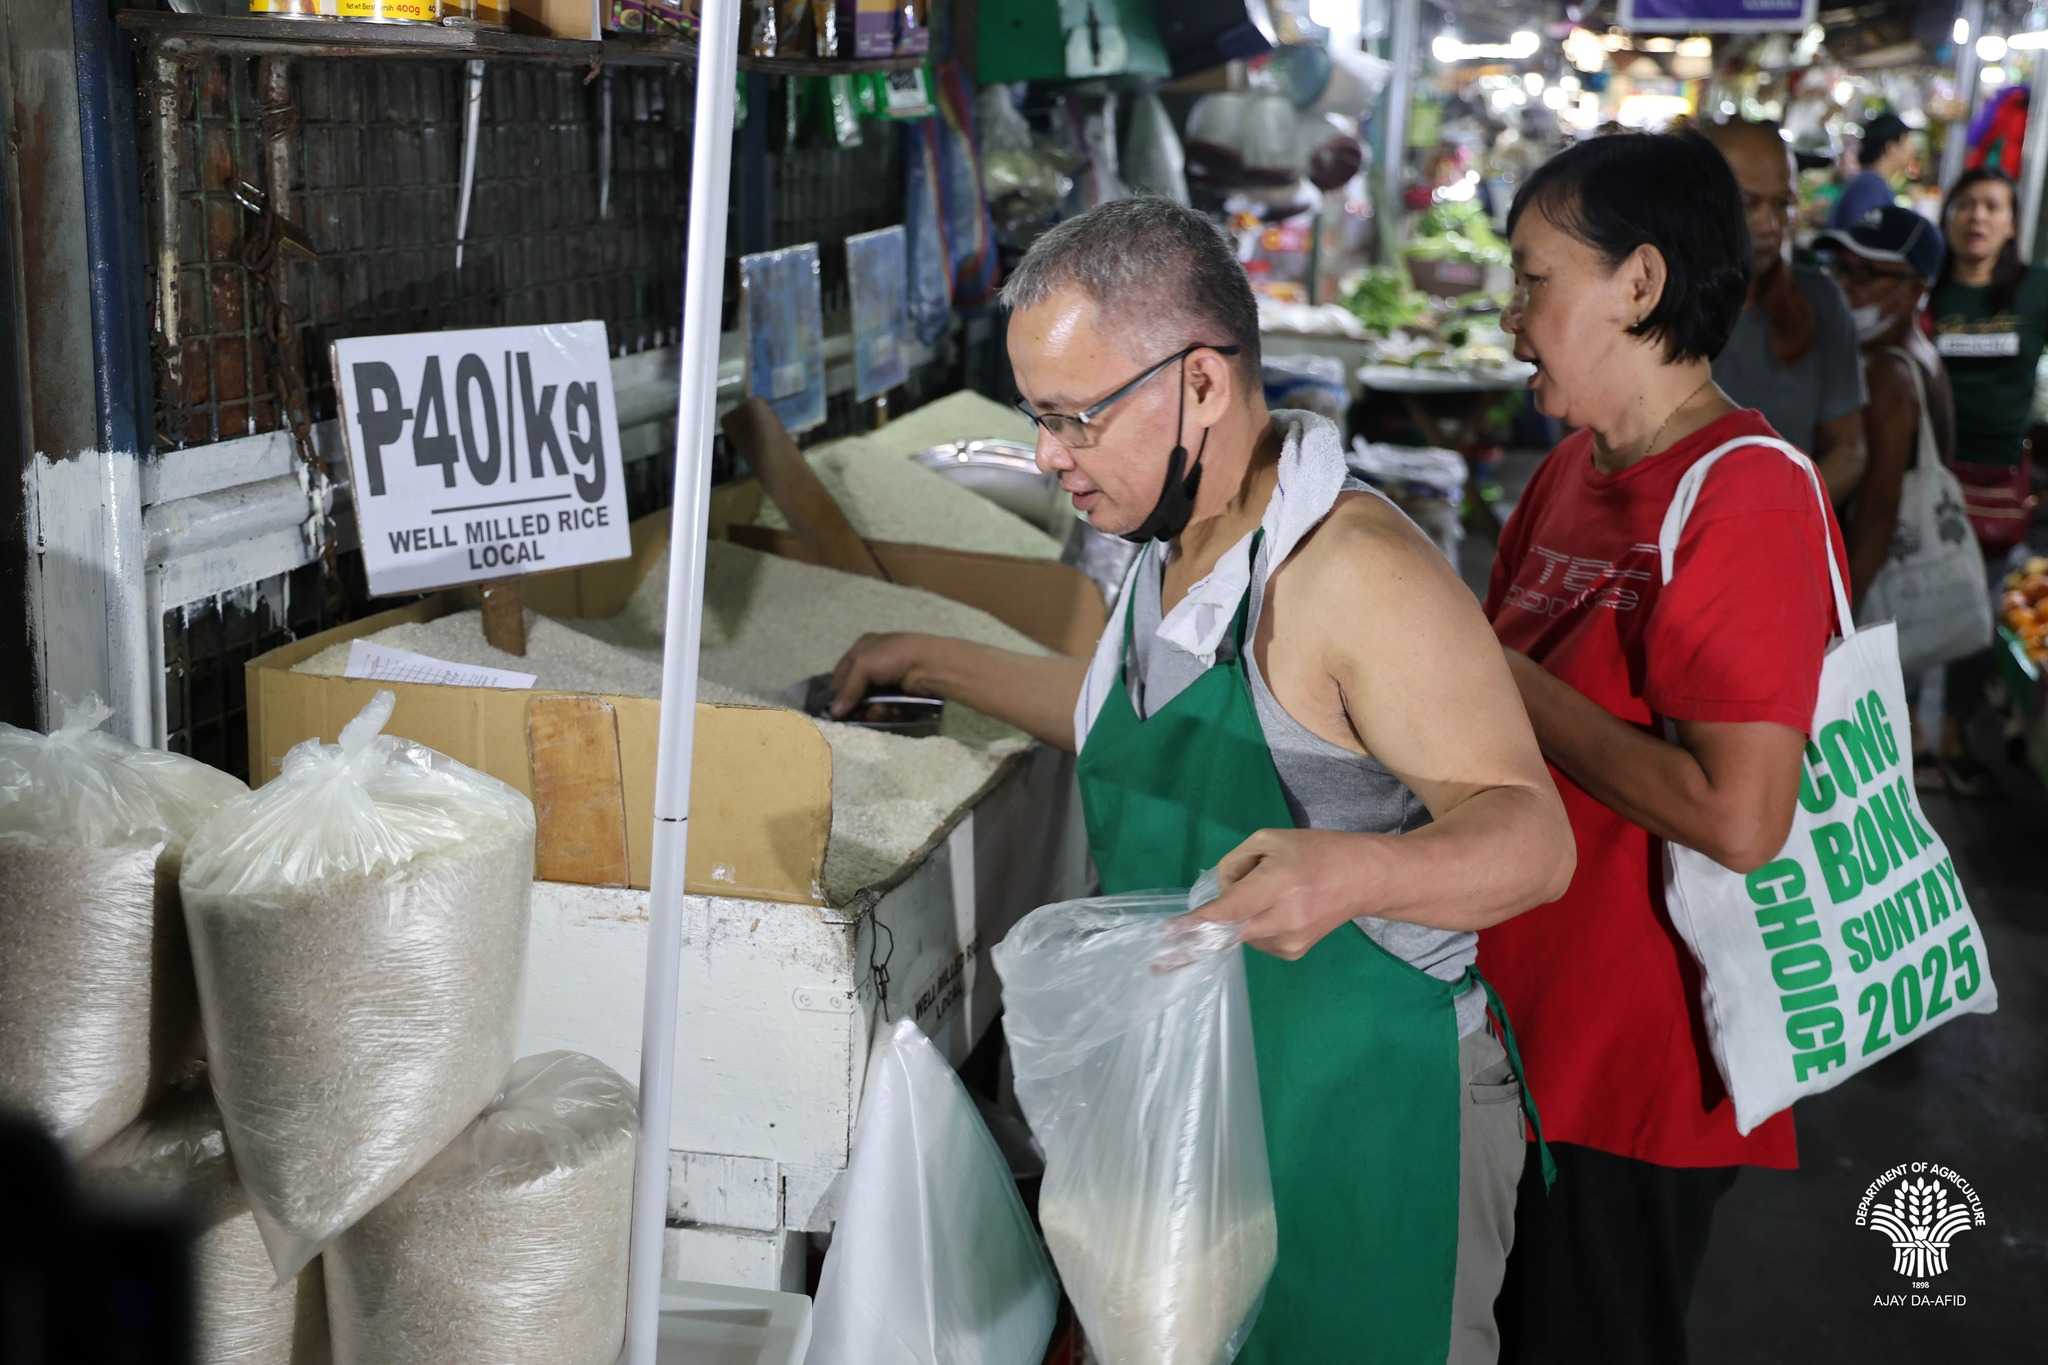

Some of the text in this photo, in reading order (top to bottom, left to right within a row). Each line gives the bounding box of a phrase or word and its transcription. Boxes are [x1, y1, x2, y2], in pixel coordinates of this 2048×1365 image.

[395, 4, 421, 16] 400g
[388, 506, 610, 554] WELL MILLED RICE
[468, 540, 546, 570] LOCAL
[1799, 689, 1900, 815] CONG
[1745, 857, 1848, 1083] CHOICE
[1841, 857, 1963, 974] SUNTAY
[1858, 925, 1980, 1056] 2025
